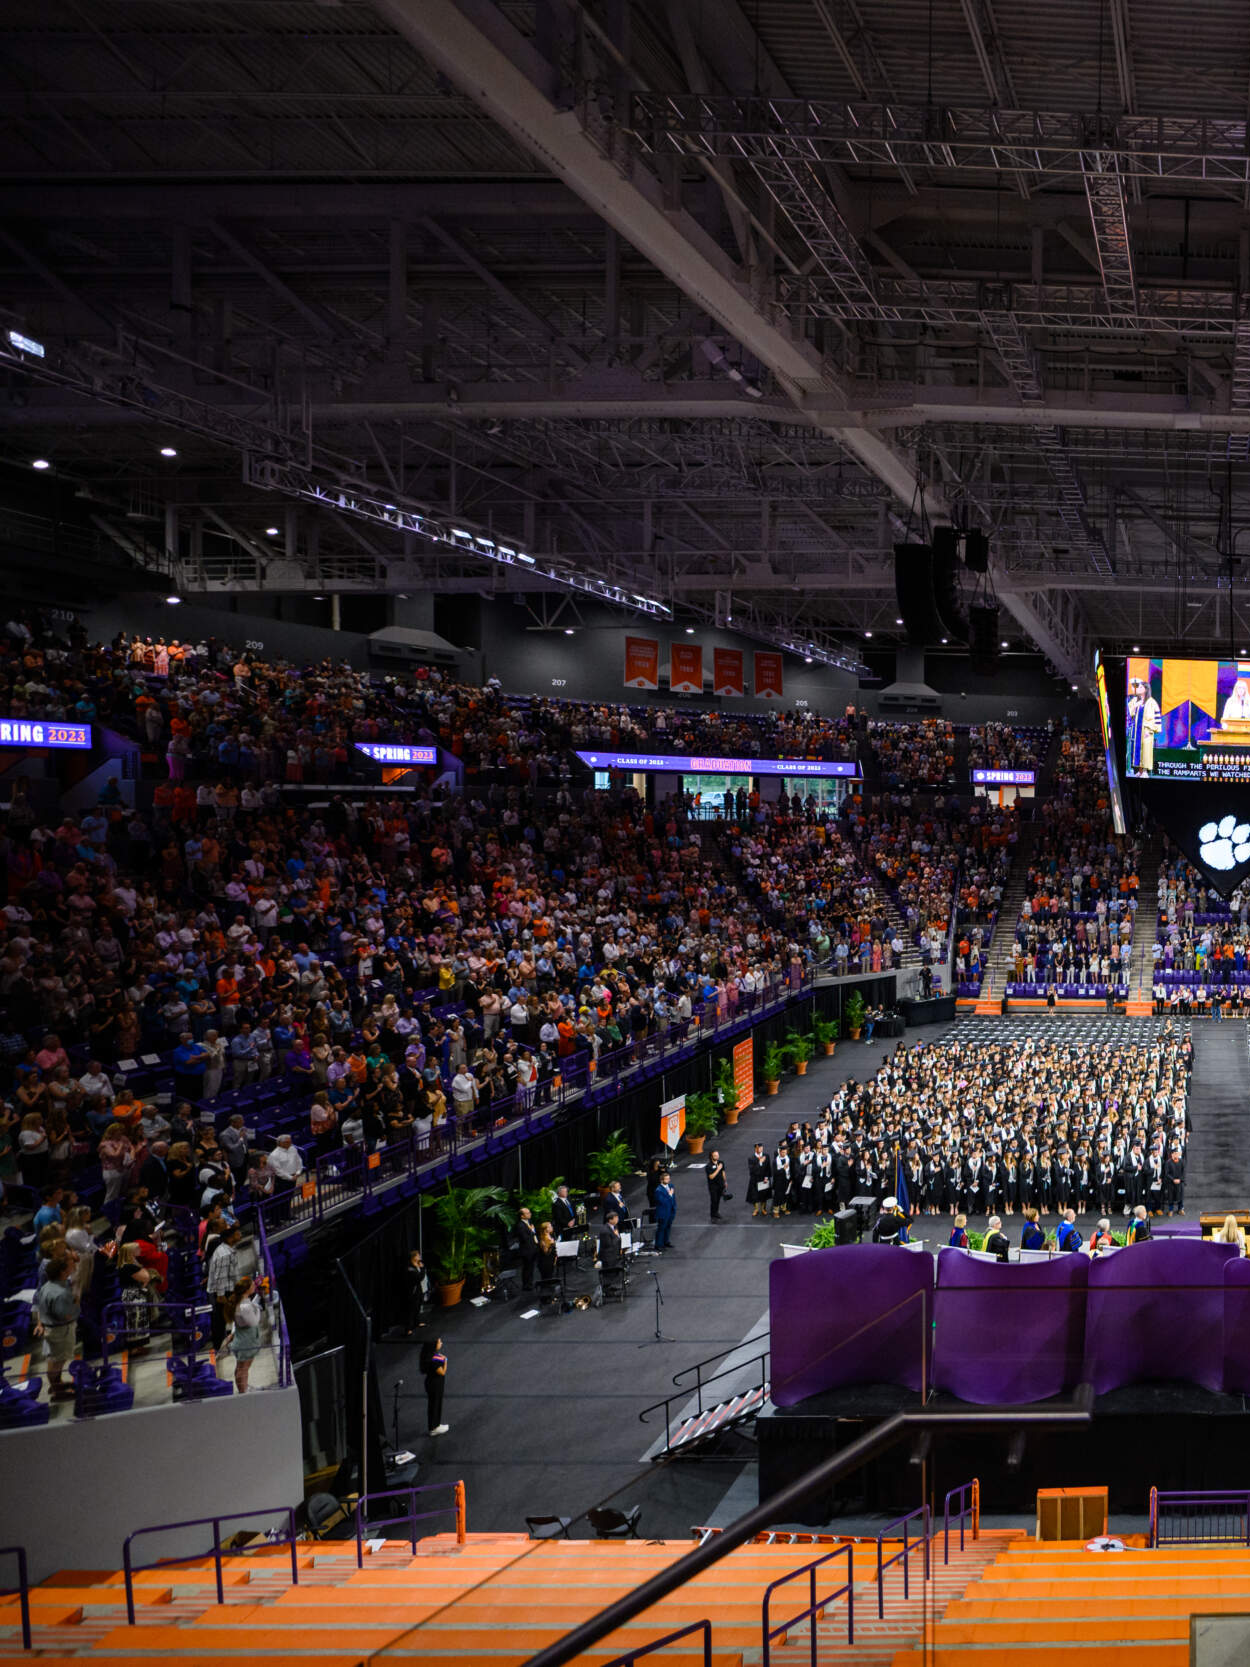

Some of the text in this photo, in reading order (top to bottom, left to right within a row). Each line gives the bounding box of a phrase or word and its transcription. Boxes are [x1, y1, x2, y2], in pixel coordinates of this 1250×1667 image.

[51, 608, 75, 622] 210
[246, 640, 264, 650] 209
[552, 679, 567, 688] 207
[48, 729, 86, 742] 2023
[373, 747, 434, 760] SPRING 2023
[690, 757, 752, 772] GRADUATION
[986, 772, 1014, 780] SPRING
[1174, 769, 1206, 777] RAMPARTS
